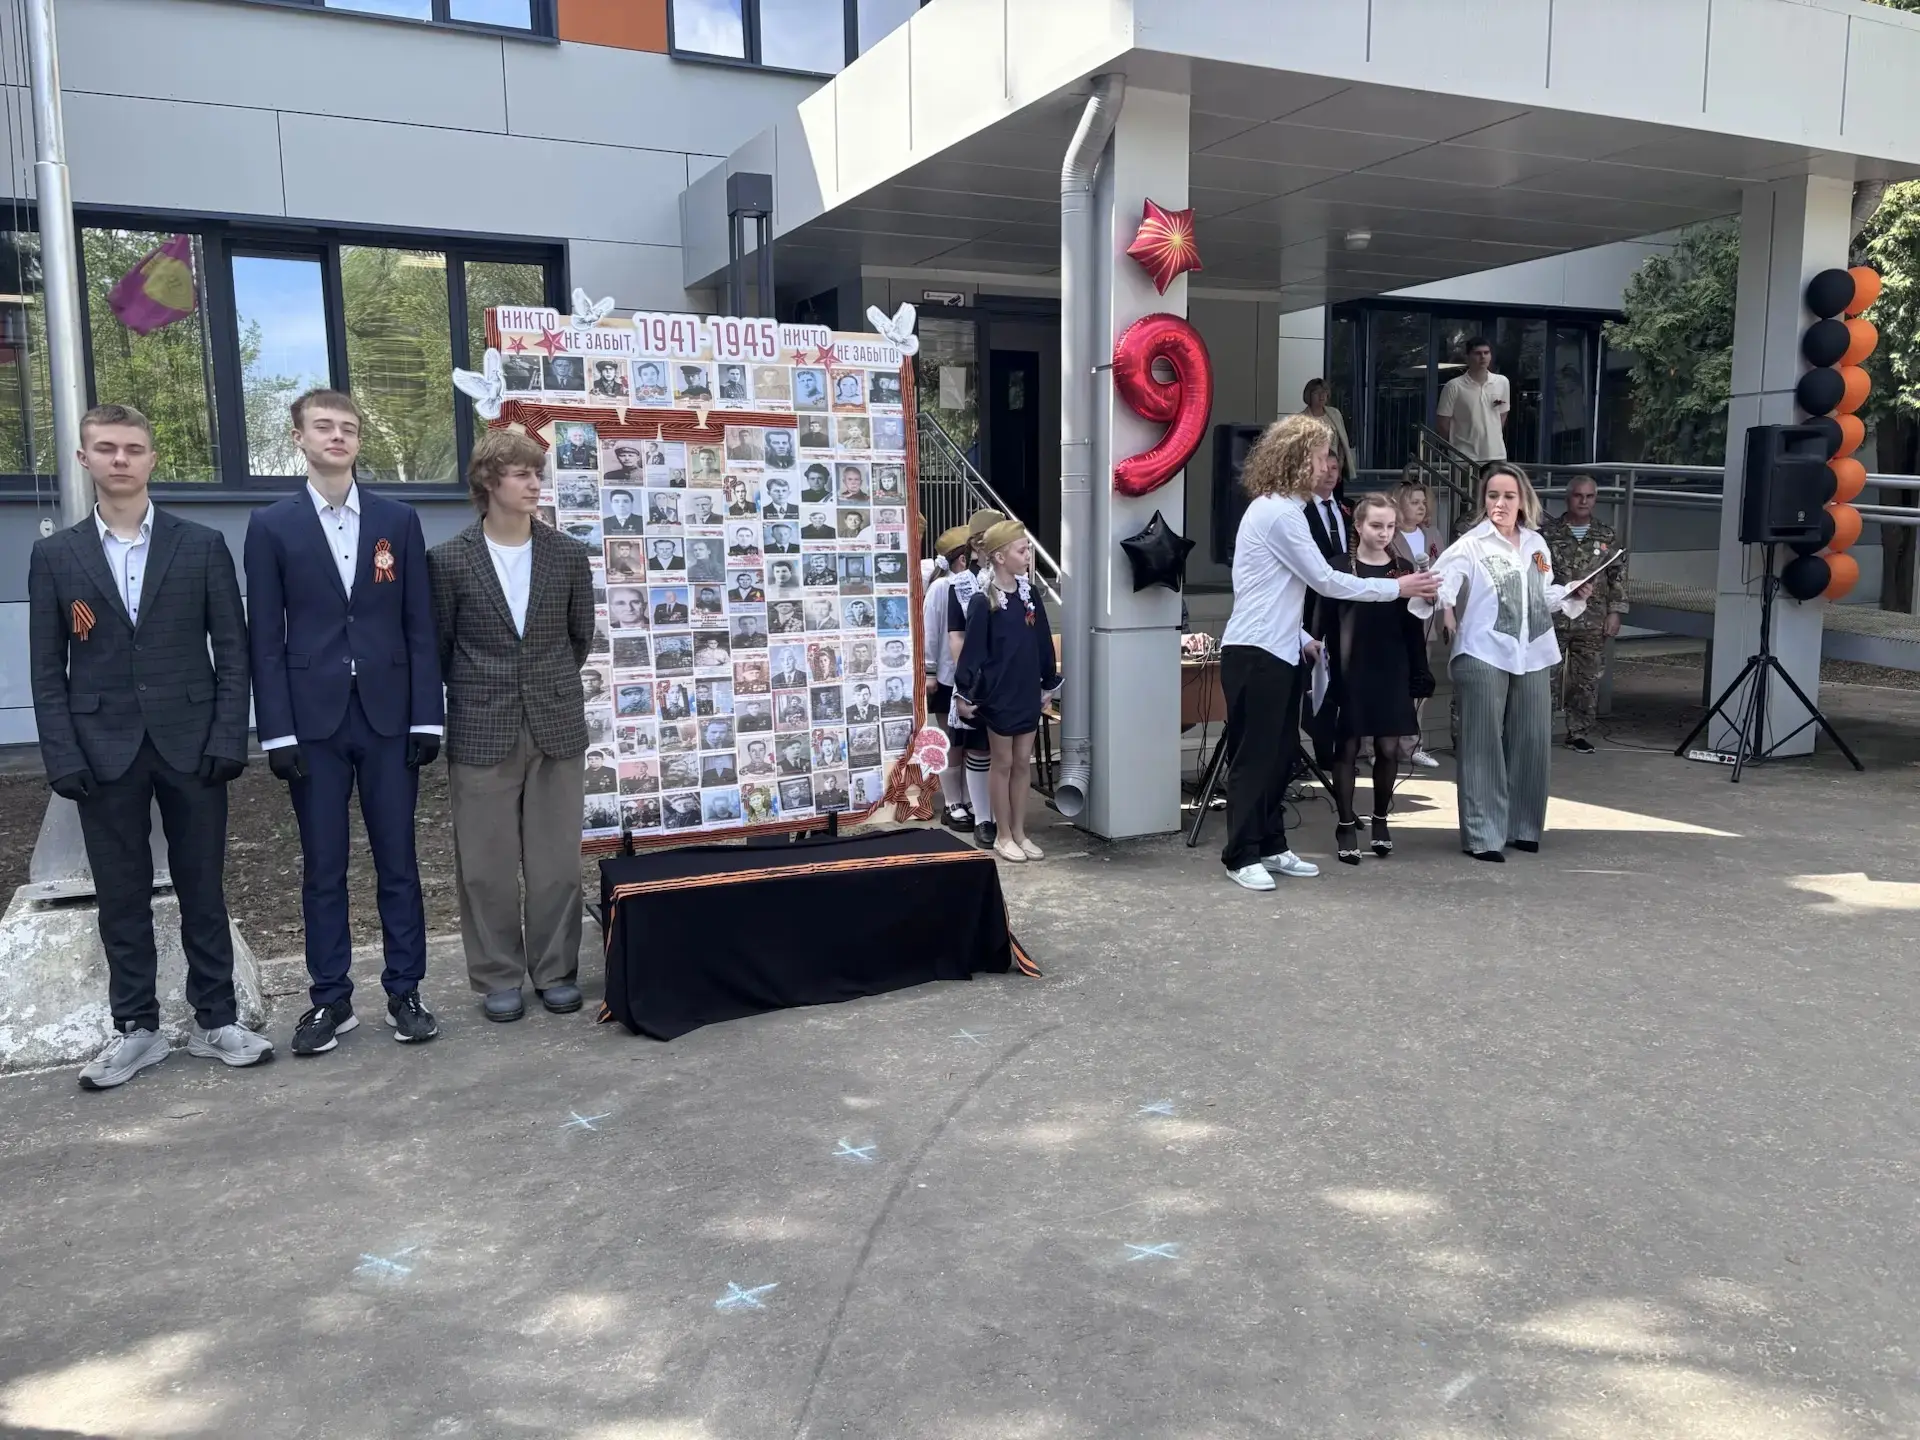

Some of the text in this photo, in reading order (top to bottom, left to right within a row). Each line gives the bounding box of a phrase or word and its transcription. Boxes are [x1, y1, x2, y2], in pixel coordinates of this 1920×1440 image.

[502, 310, 555, 331] НИКТО
[564, 332, 634, 353] НЕ ЗАБЫТ,
[783, 328, 828, 347] НИЧТО
[837, 344, 900, 364] НЕ ЗАБЫТО!
[1112, 312, 1214, 497] 9
